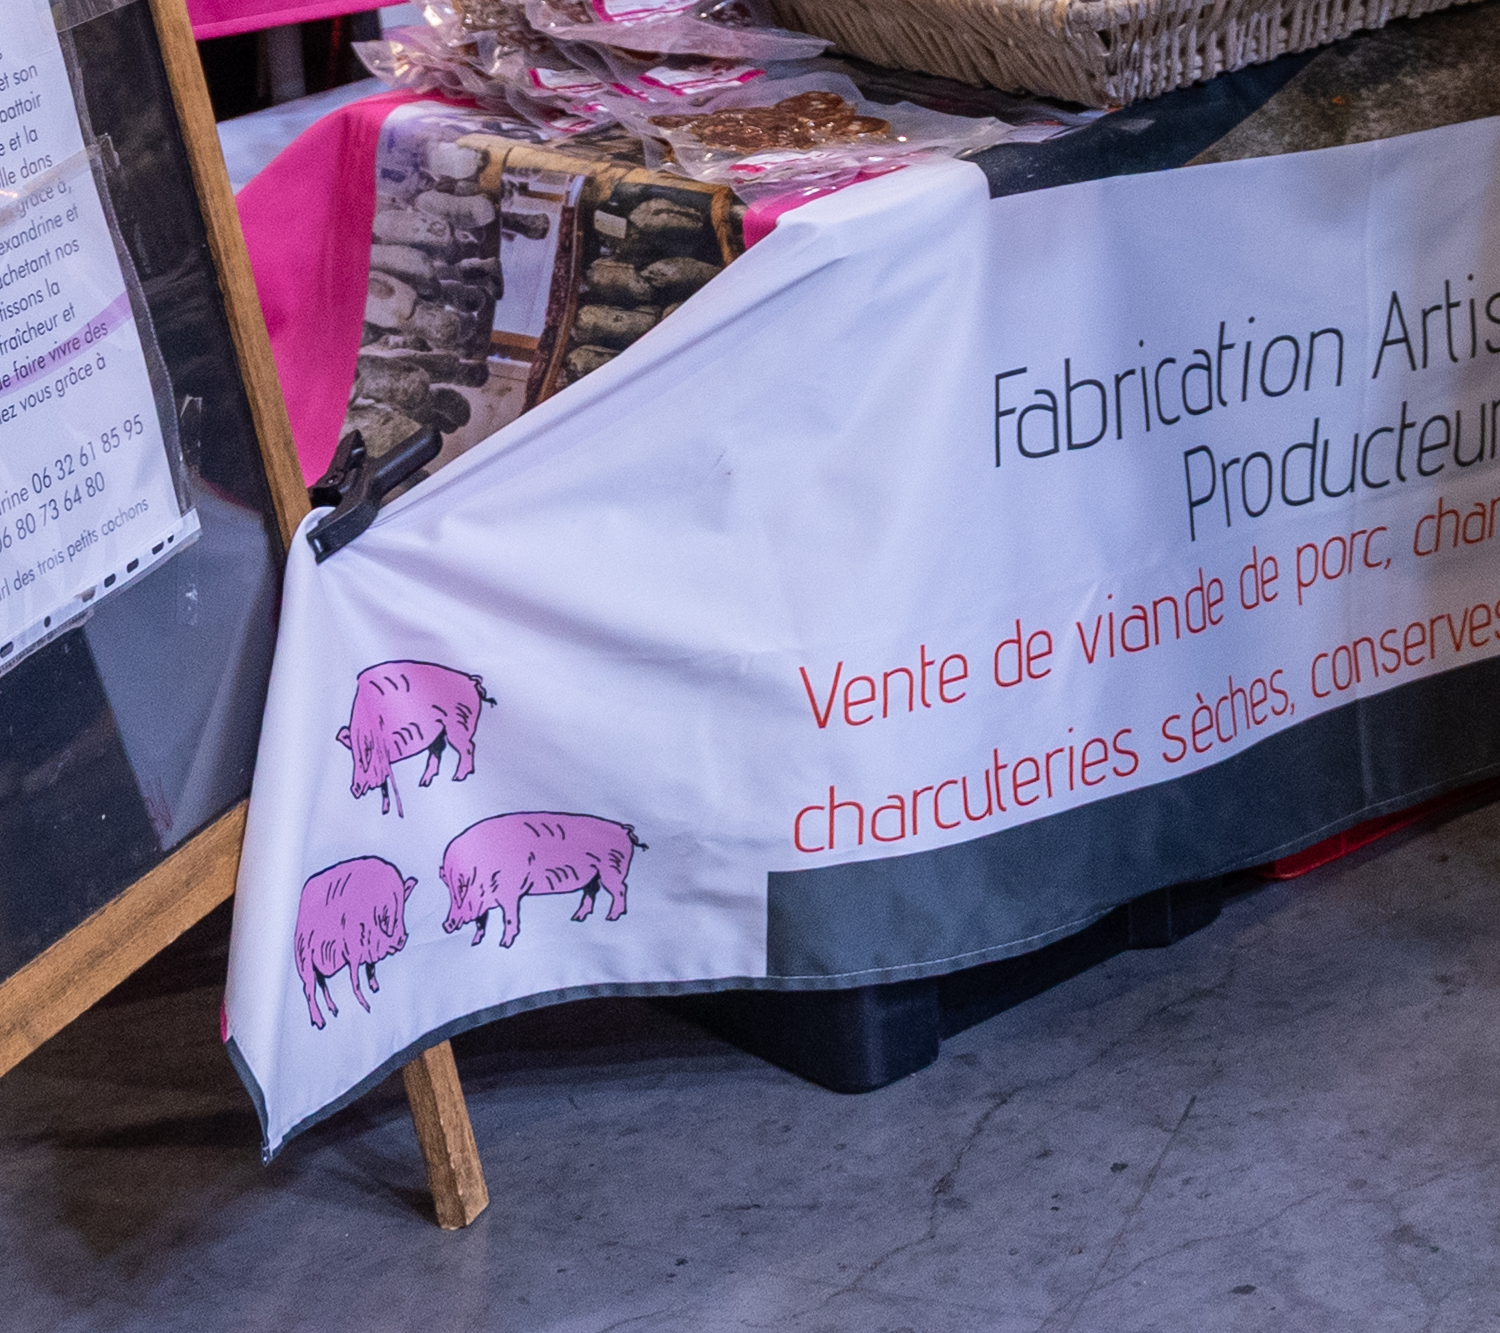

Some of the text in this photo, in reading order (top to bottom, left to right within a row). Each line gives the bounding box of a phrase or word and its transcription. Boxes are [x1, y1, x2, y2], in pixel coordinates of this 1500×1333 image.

[31, 467, 51, 493] 06
[54, 453, 74, 480] 32
[79, 441, 95, 466] 61
[100, 427, 119, 453] 85
[123, 414, 143, 439] 95
[992, 313, 1345, 470] Fabrication
[13, 569, 35, 590] des
[37, 549, 64, 574] trois
[66, 529, 97, 561] petits
[101, 499, 148, 535] cochons
[15, 512, 35, 539] 80
[38, 498, 59, 525] 73
[63, 484, 81, 511] 64
[85, 471, 104, 497] 80
[798, 642, 970, 734] Vente
[994, 616, 1053, 691] de
[1077, 565, 1227, 669] viande
[1238, 546, 1280, 612] de
[1296, 523, 1393, 605] porc,
[793, 718, 1139, 856] charcuteries
[1162, 662, 1297, 763] sèches,
